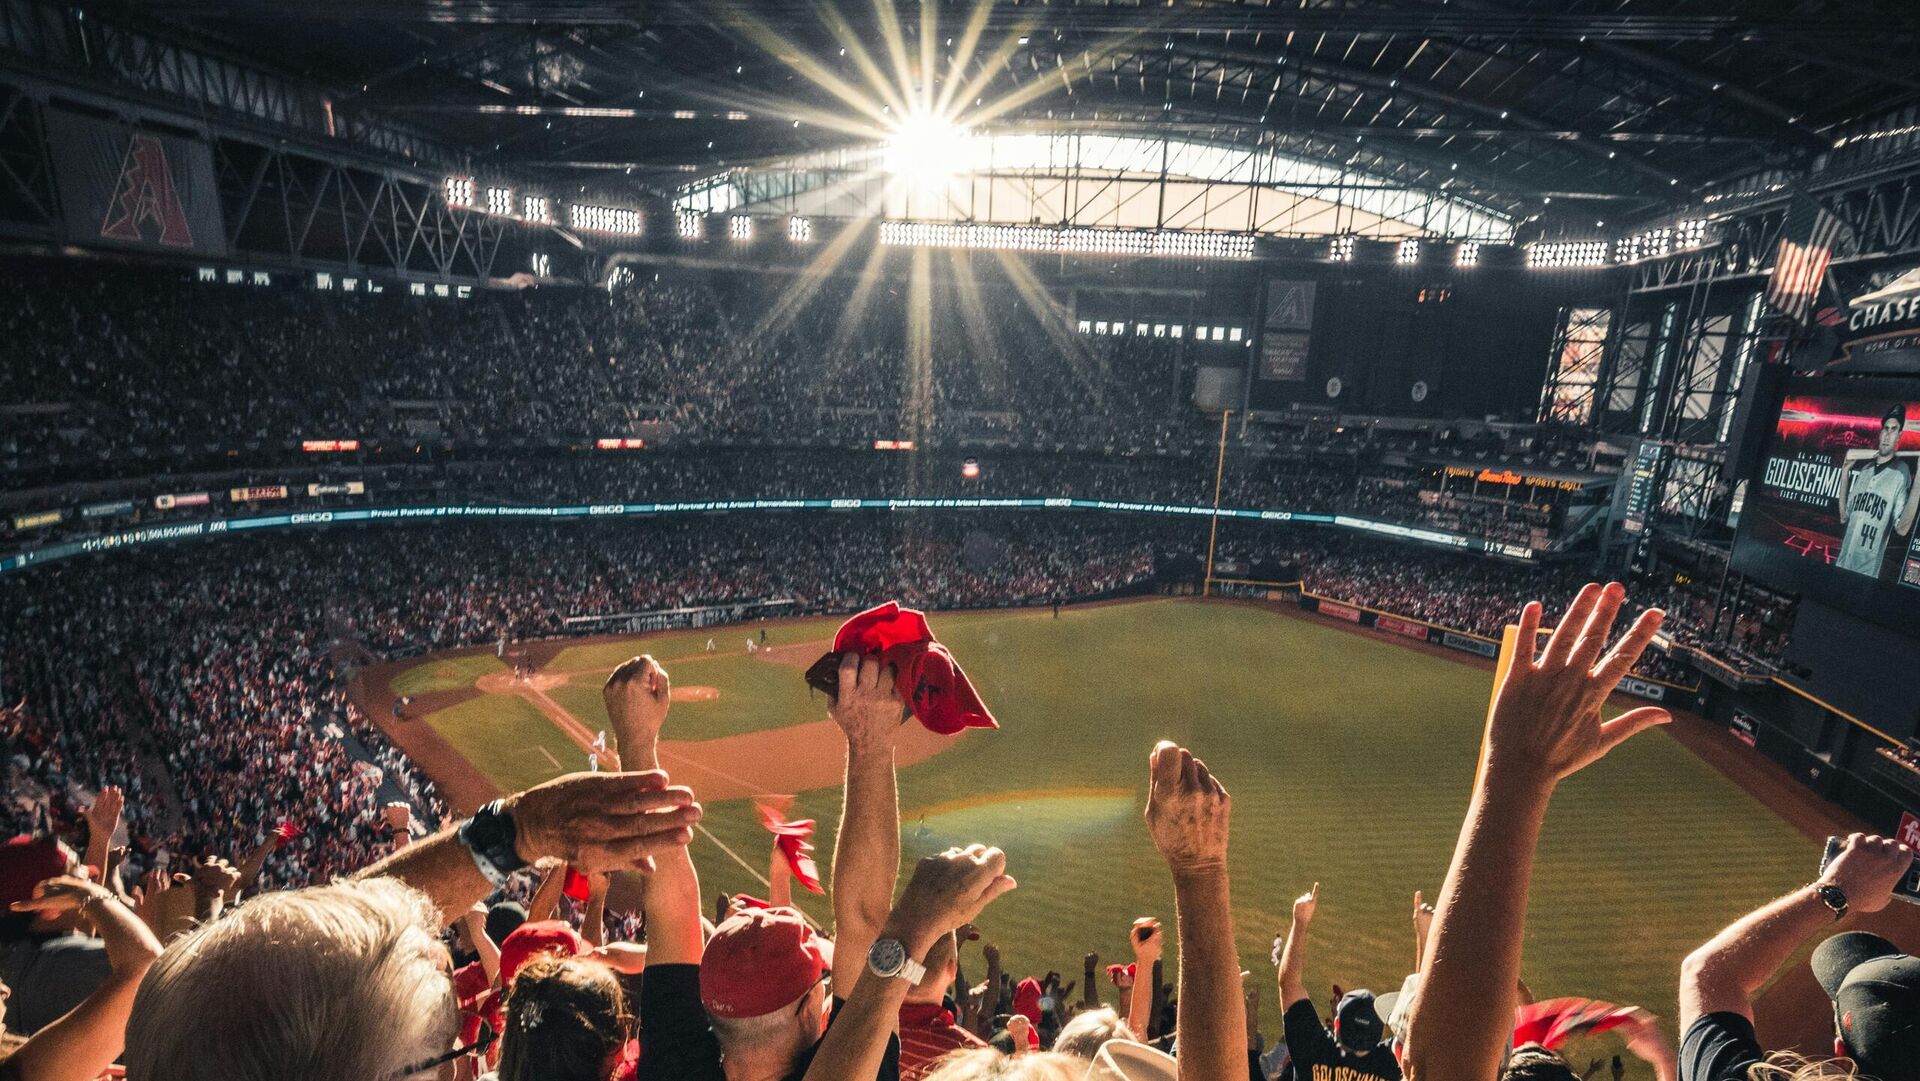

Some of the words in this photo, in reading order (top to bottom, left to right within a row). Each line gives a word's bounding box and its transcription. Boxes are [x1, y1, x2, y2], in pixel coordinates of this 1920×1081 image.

[101, 134, 193, 247] A
[1850, 296, 1920, 331] CHASE
[1525, 475, 1556, 488] SPORTS
[589, 504, 624, 515] GEICO
[831, 499, 862, 508] GEICO
[1044, 499, 1072, 507] GEICO
[291, 512, 333, 524] GEICO
[1261, 511, 1292, 520] GEICO
[149, 522, 203, 540] GOLDSCHMIDT
[1861, 523, 1878, 550] 44
[1615, 677, 1666, 701] EICO
